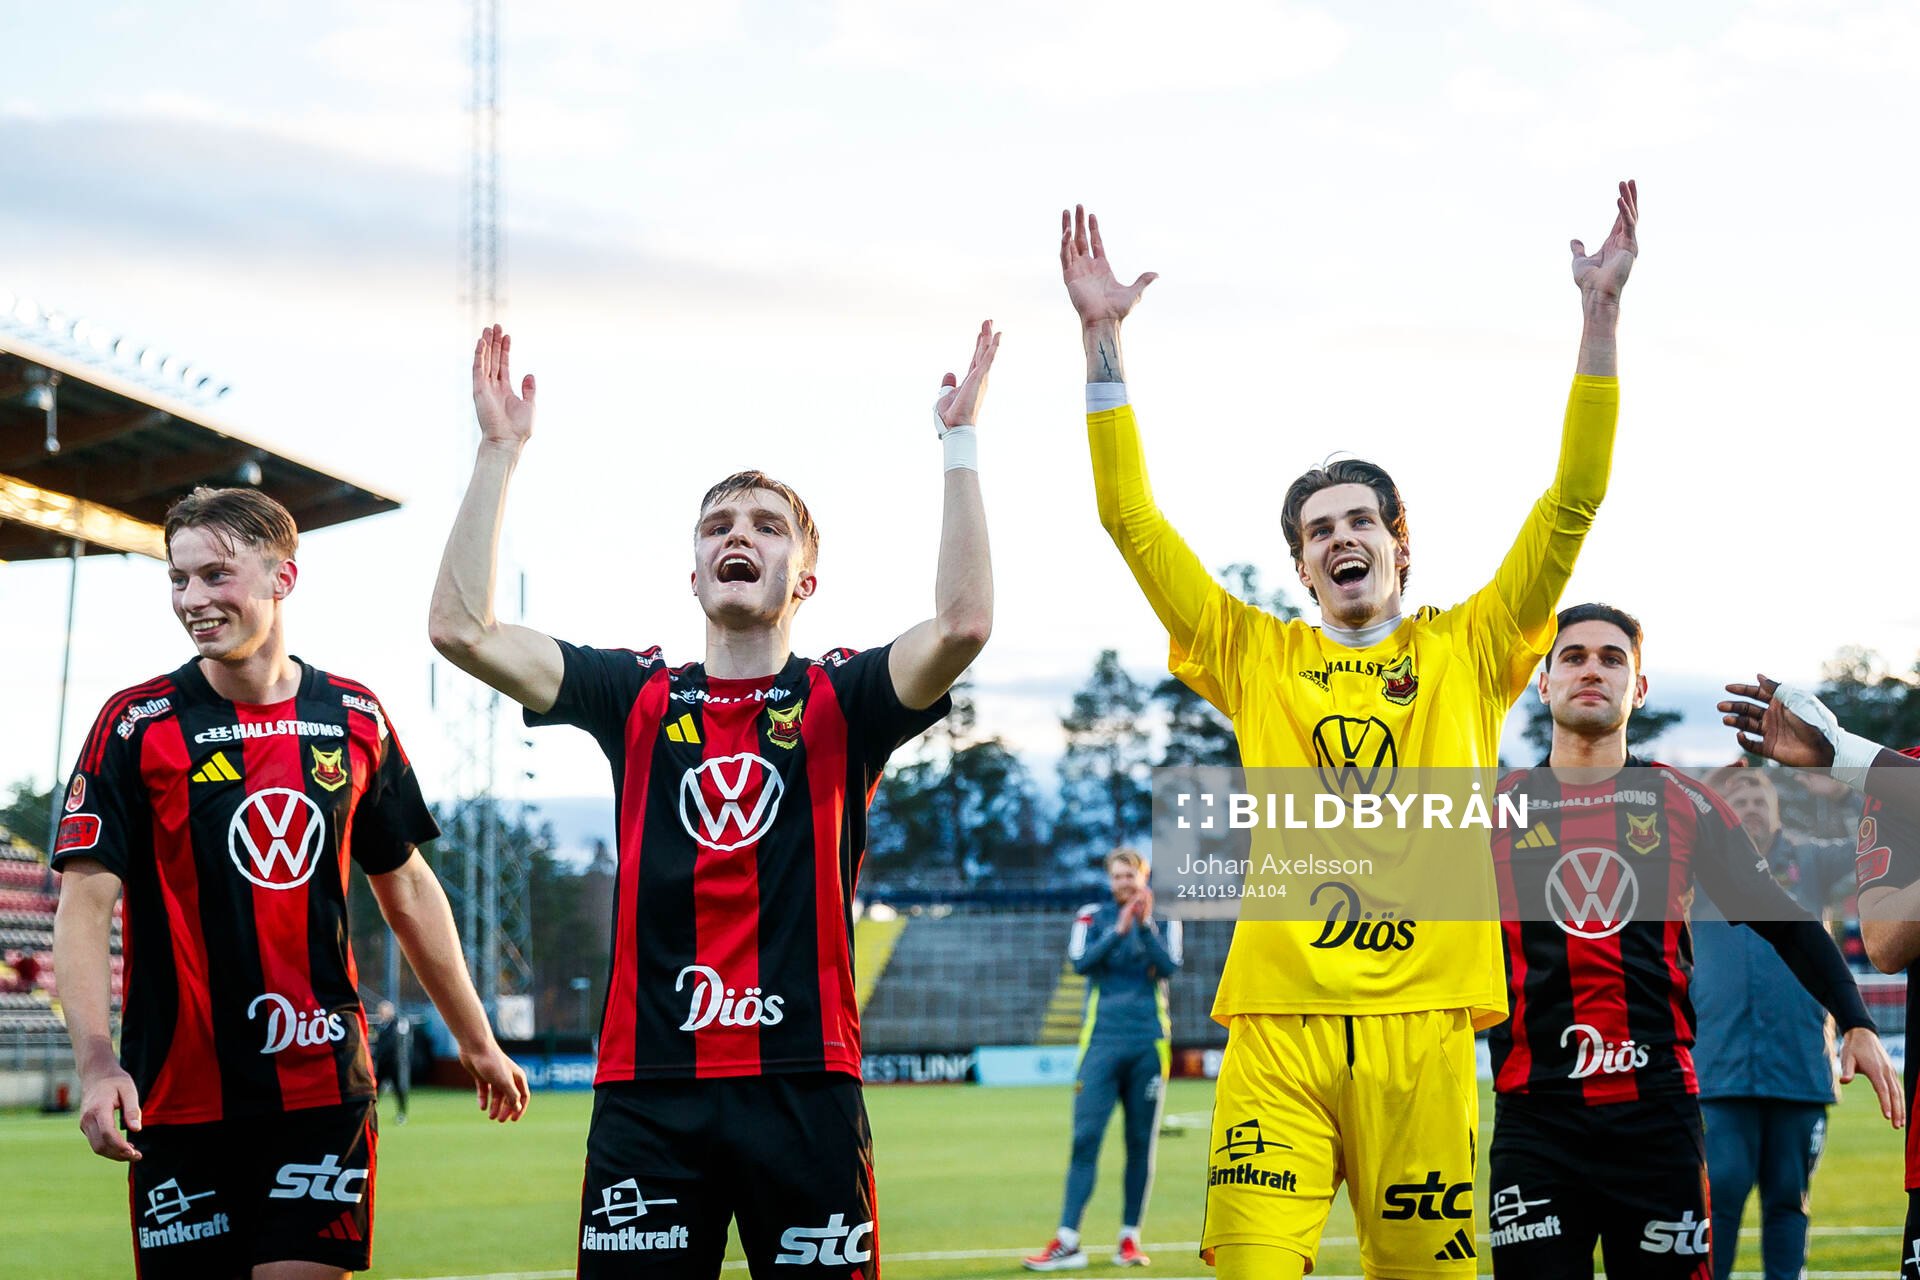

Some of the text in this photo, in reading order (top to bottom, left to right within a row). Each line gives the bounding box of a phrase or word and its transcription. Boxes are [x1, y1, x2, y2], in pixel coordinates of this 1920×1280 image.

[683, 753, 782, 846] VW
[231, 790, 323, 884] VW
[1309, 881, 1416, 952] Diös
[1548, 850, 1636, 933] VW
[248, 993, 346, 1054] Diös
[674, 965, 784, 1031] Diös
[1560, 1023, 1650, 1079] Diös
[269, 1154, 368, 1202] stc
[1209, 1163, 1297, 1193] ämtkraft
[1382, 1171, 1473, 1220] stc
[582, 1225, 689, 1251] Jämtkraft
[775, 1213, 874, 1266] stc
[1490, 1215, 1562, 1248] mtkraft
